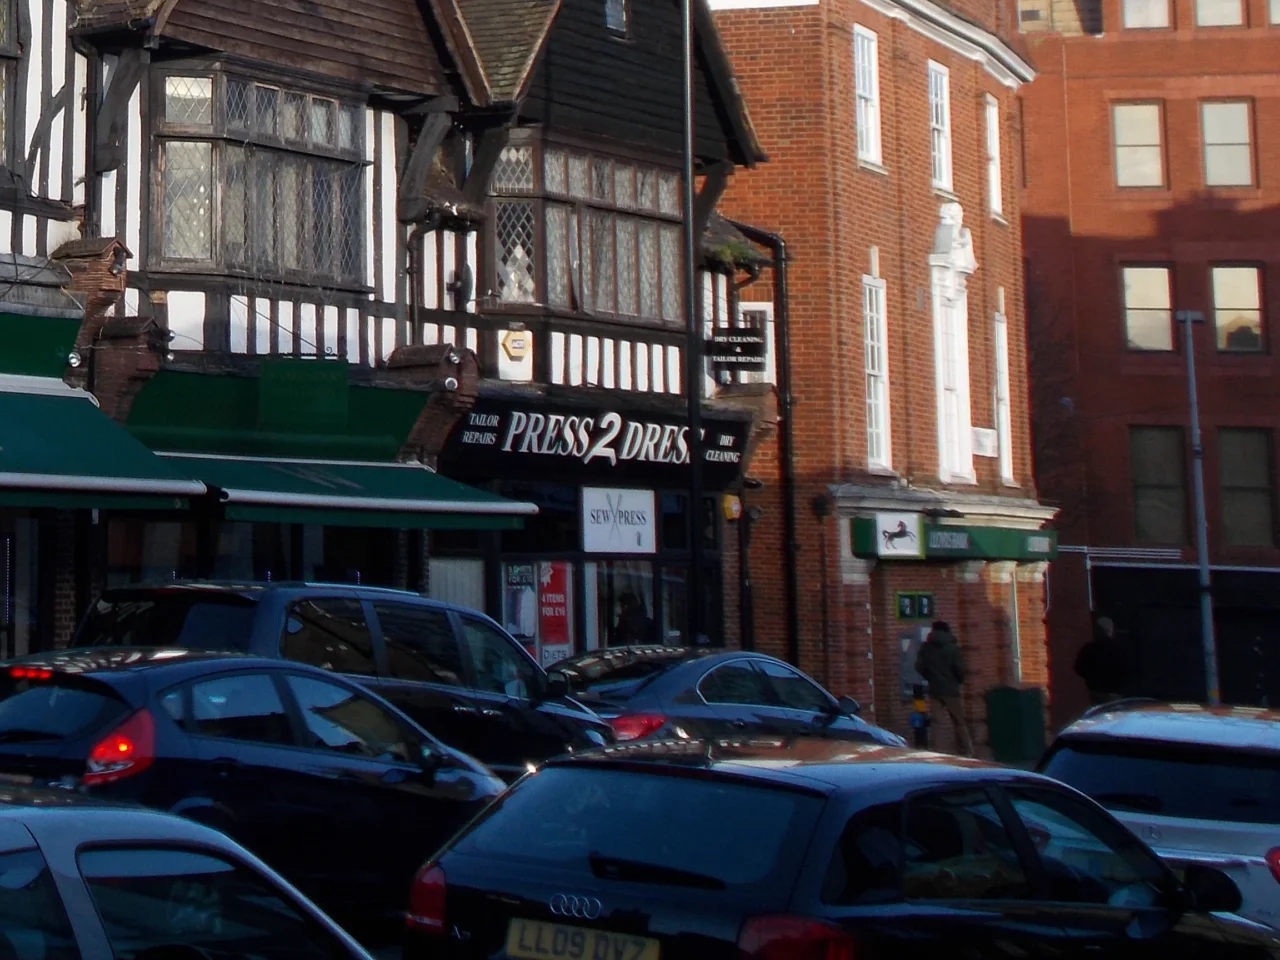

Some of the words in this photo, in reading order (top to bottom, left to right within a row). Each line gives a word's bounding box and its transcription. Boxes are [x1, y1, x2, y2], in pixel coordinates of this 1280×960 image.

[470, 412, 500, 427] TAILOR
[462, 430, 498, 445] REPAIRS
[501, 411, 595, 457] PRESS
[584, 412, 622, 466] 2
[619, 421, 705, 464] DRES
[720, 434, 736, 446] DRY
[705, 449, 741, 464] CLEANING
